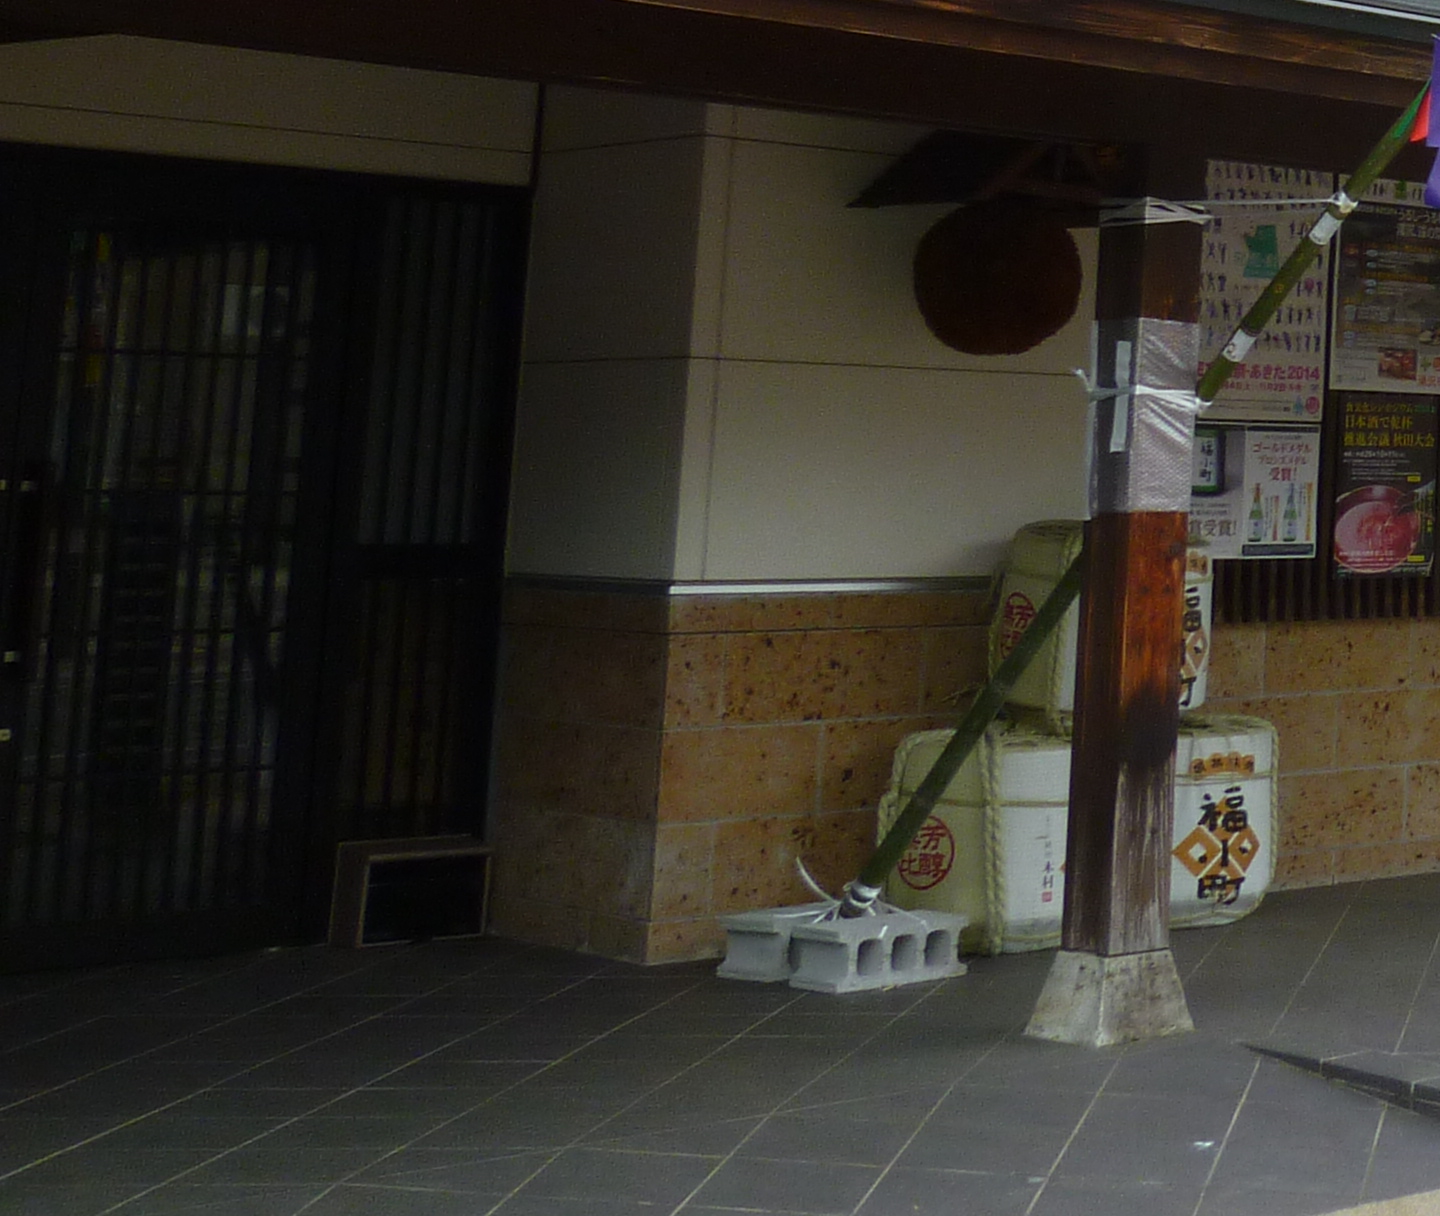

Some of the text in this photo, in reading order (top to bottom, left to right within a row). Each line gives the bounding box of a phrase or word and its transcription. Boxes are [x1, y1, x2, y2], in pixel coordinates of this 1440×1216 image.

[1393, 432, 1436, 448] 秋田大会
[1198, 786, 1248, 905] 福小町
